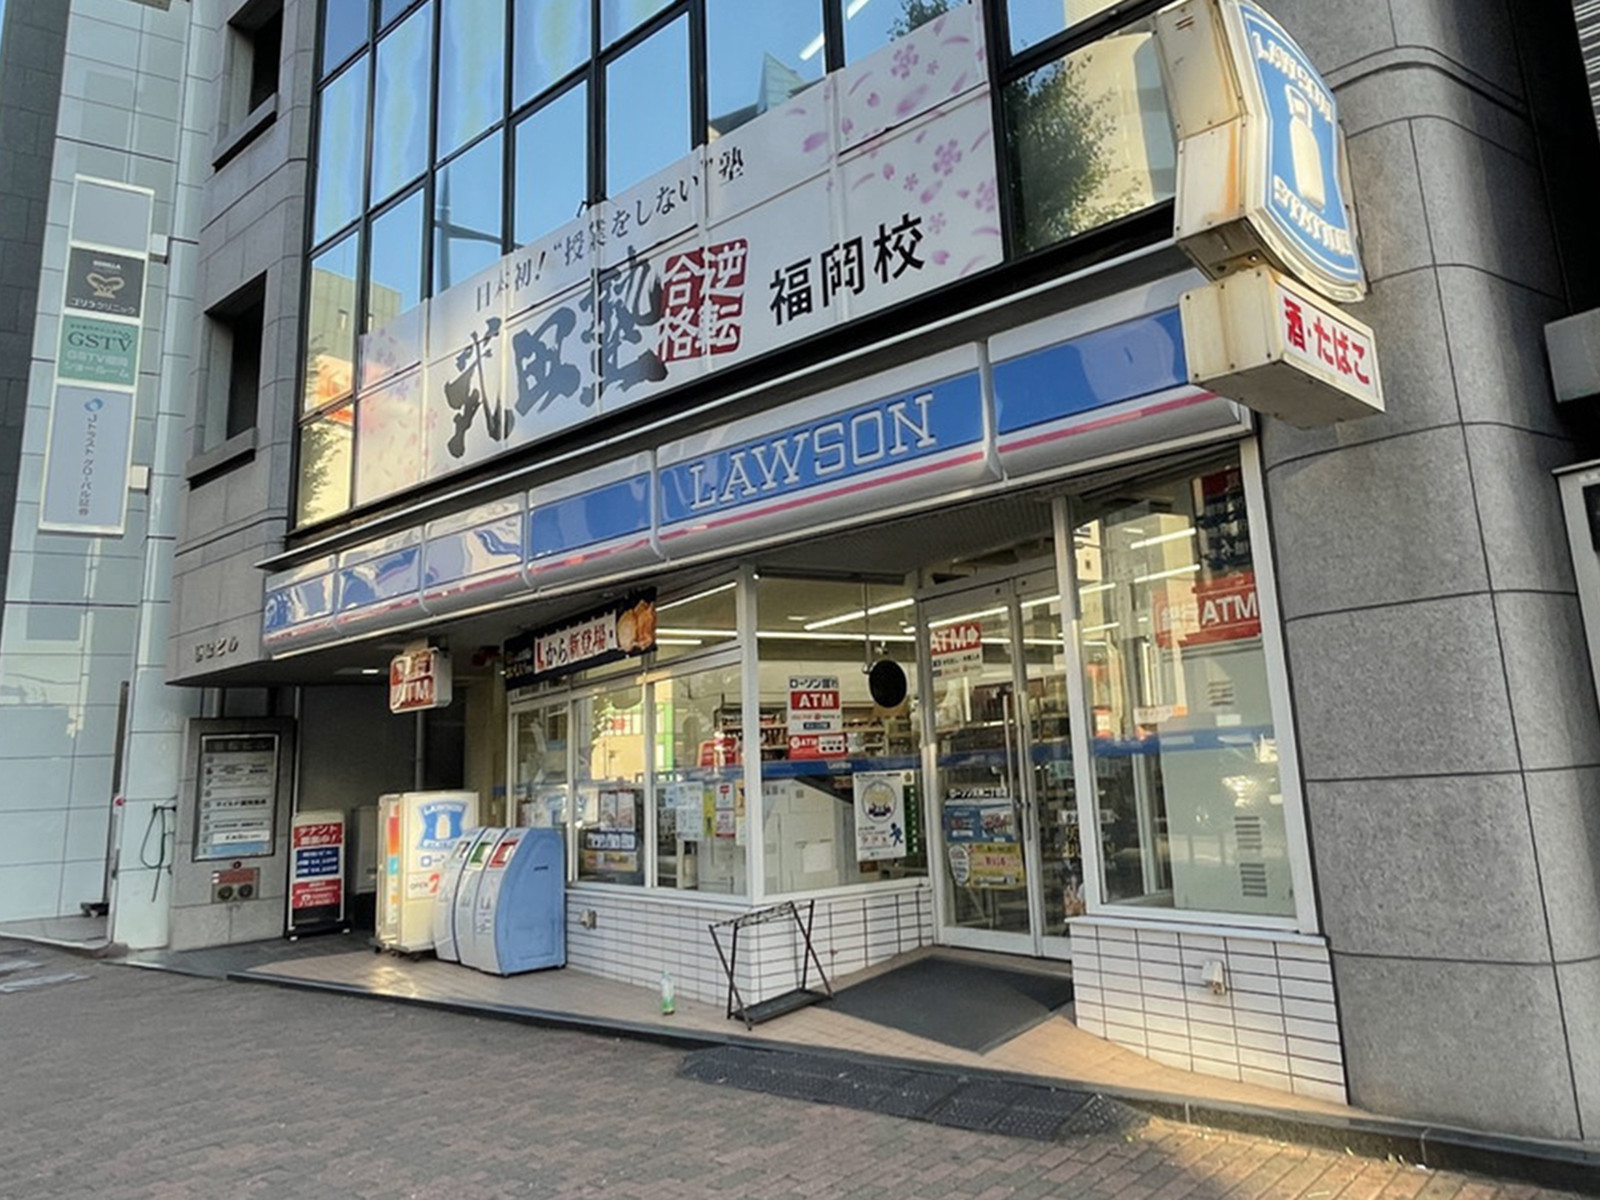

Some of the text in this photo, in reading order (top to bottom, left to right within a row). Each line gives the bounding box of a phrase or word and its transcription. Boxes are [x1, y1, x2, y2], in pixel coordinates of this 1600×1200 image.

[769, 212, 926, 326] 福岡校
[71, 297, 137, 315] ゴリラクリニック
[67, 330, 132, 352] GSTV
[1284, 296, 1370, 384] 酒・たばこ
[690, 393, 937, 510] LAWSON
[1201, 592, 1258, 626] ATM
[930, 626, 966, 652] ATM
[799, 693, 834, 707] ATM
[801, 738, 818, 746] ATM
[299, 825, 338, 837] テナント
